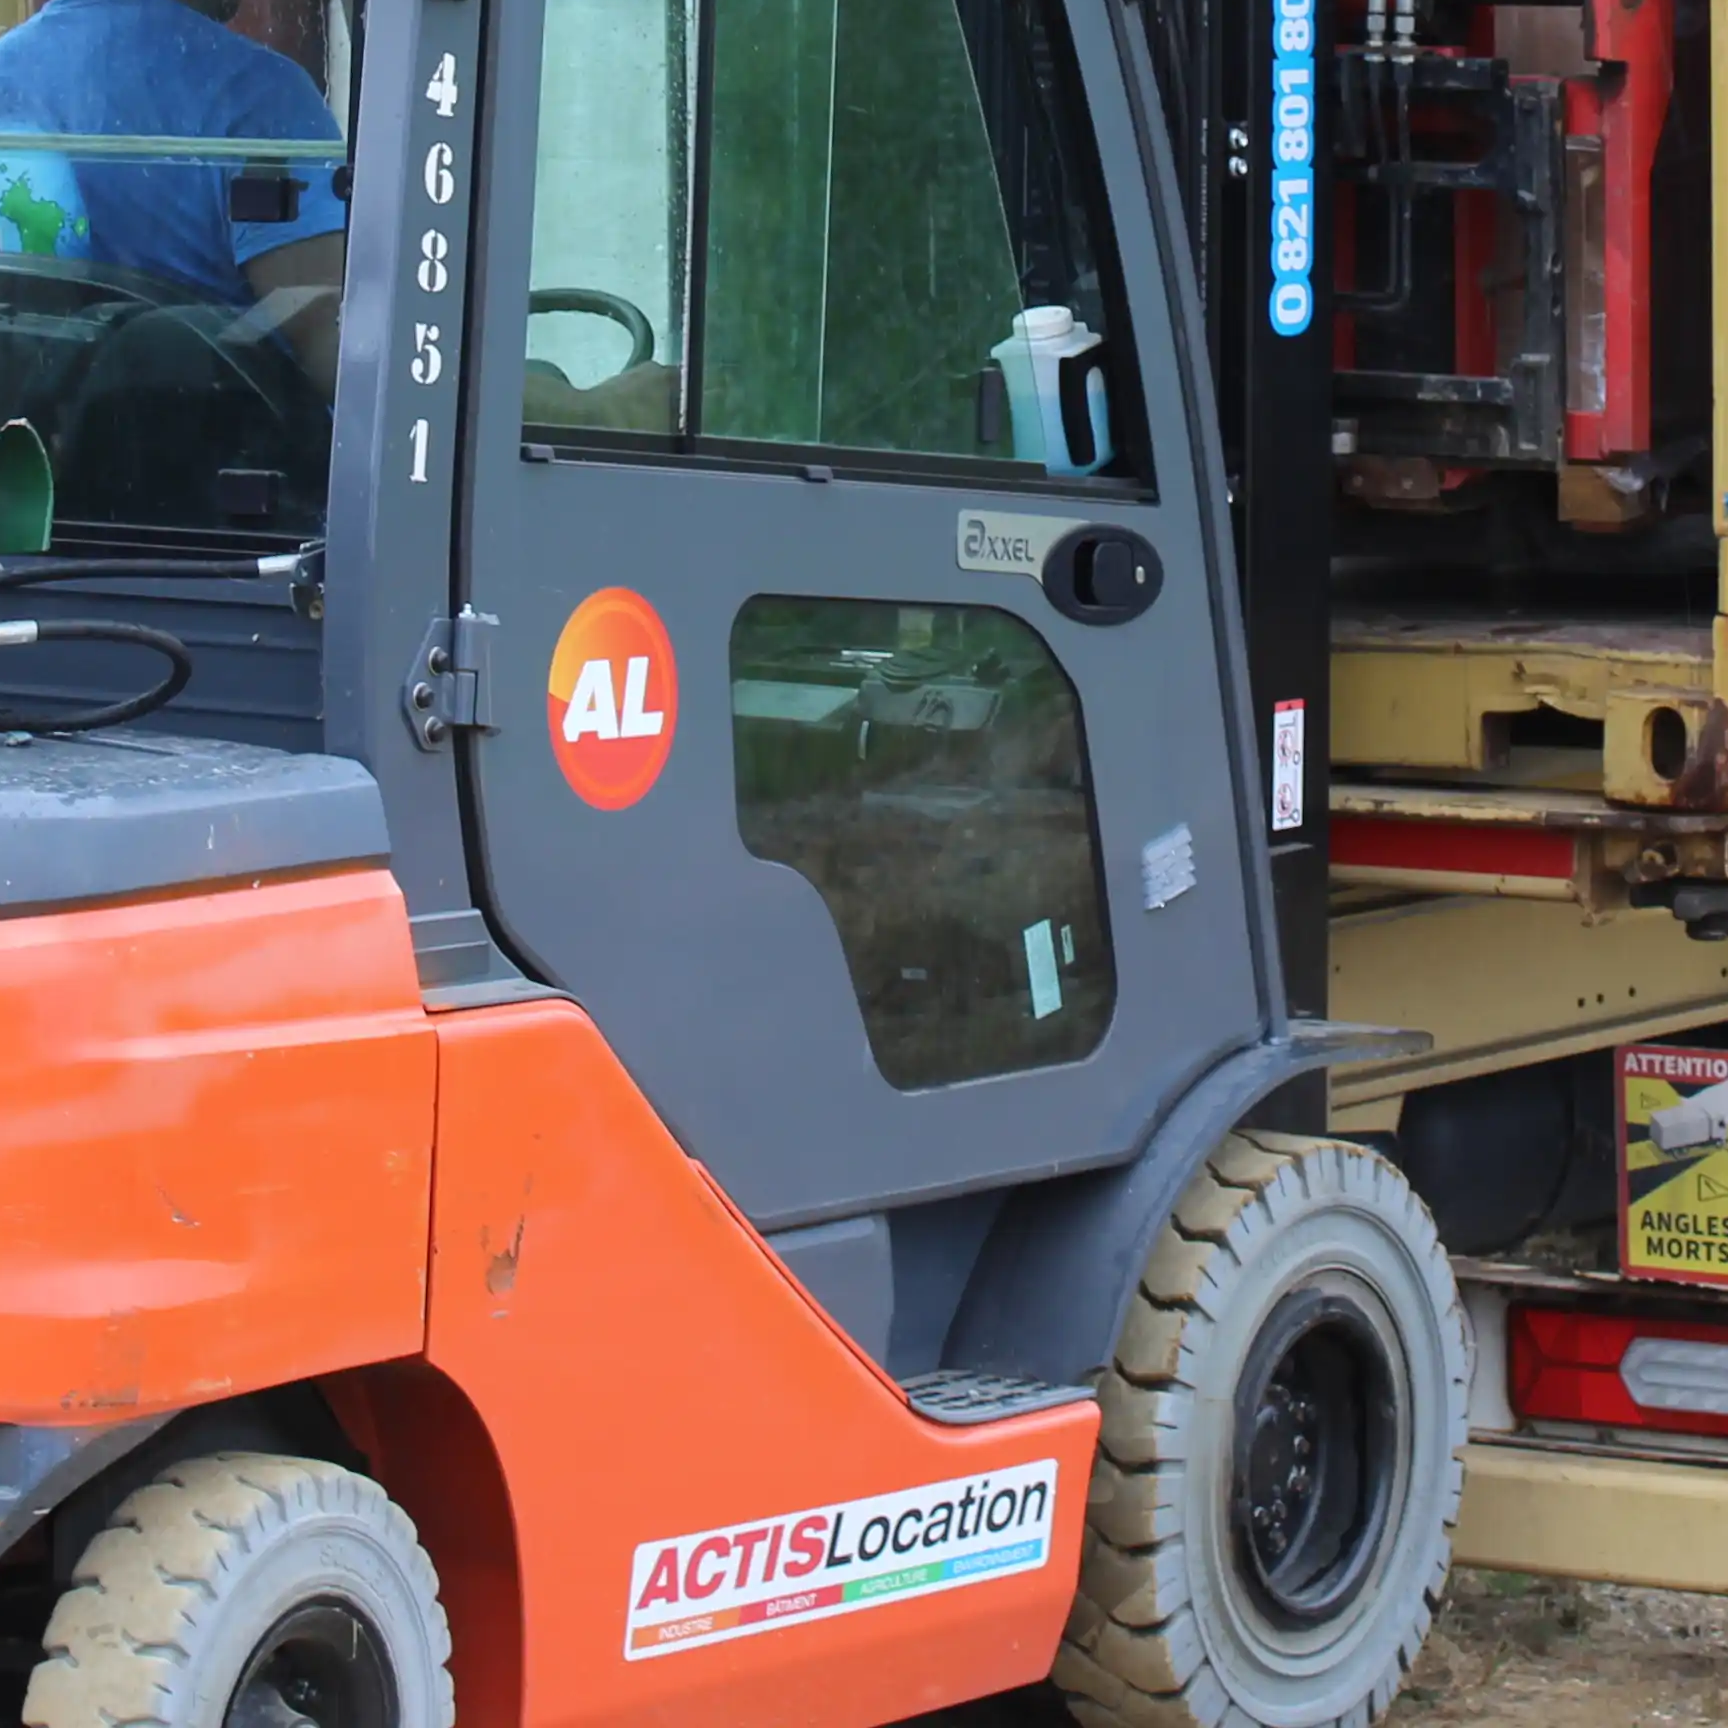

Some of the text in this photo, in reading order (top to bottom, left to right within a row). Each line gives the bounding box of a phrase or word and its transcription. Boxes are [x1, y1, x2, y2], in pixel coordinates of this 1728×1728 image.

[1278, 68, 1309, 162] 801
[1277, 178, 1308, 272] 821
[562, 655, 665, 743] AL
[658, 1615, 714, 1642] INDUSTRIE
[859, 1567, 928, 1596] AGRICULTURE
[952, 1544, 1036, 1575] ENVIRONNEMENT
